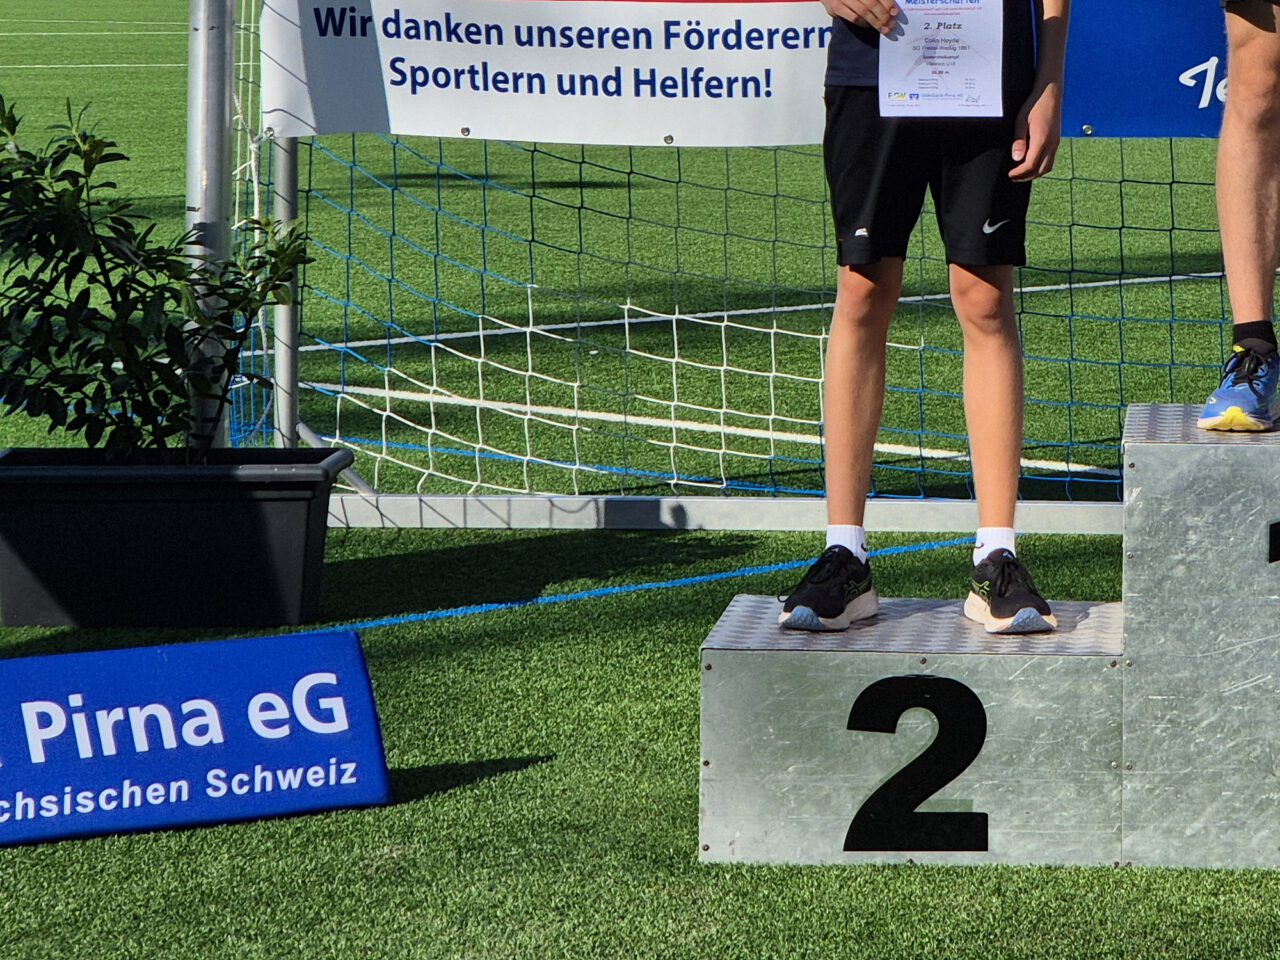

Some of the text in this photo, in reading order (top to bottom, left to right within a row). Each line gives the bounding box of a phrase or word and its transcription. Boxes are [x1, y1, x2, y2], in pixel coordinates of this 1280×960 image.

[314, 7, 373, 38] Wir
[382, 10, 503, 45] danken
[514, 20, 653, 49] unseren
[923, 22, 962, 30] 2. Platz
[388, 56, 773, 98] Sportlern und Helfern!
[21, 672, 349, 763] Pirna eG
[206, 757, 357, 798] Schweiz
[844, 676, 990, 851] 2
